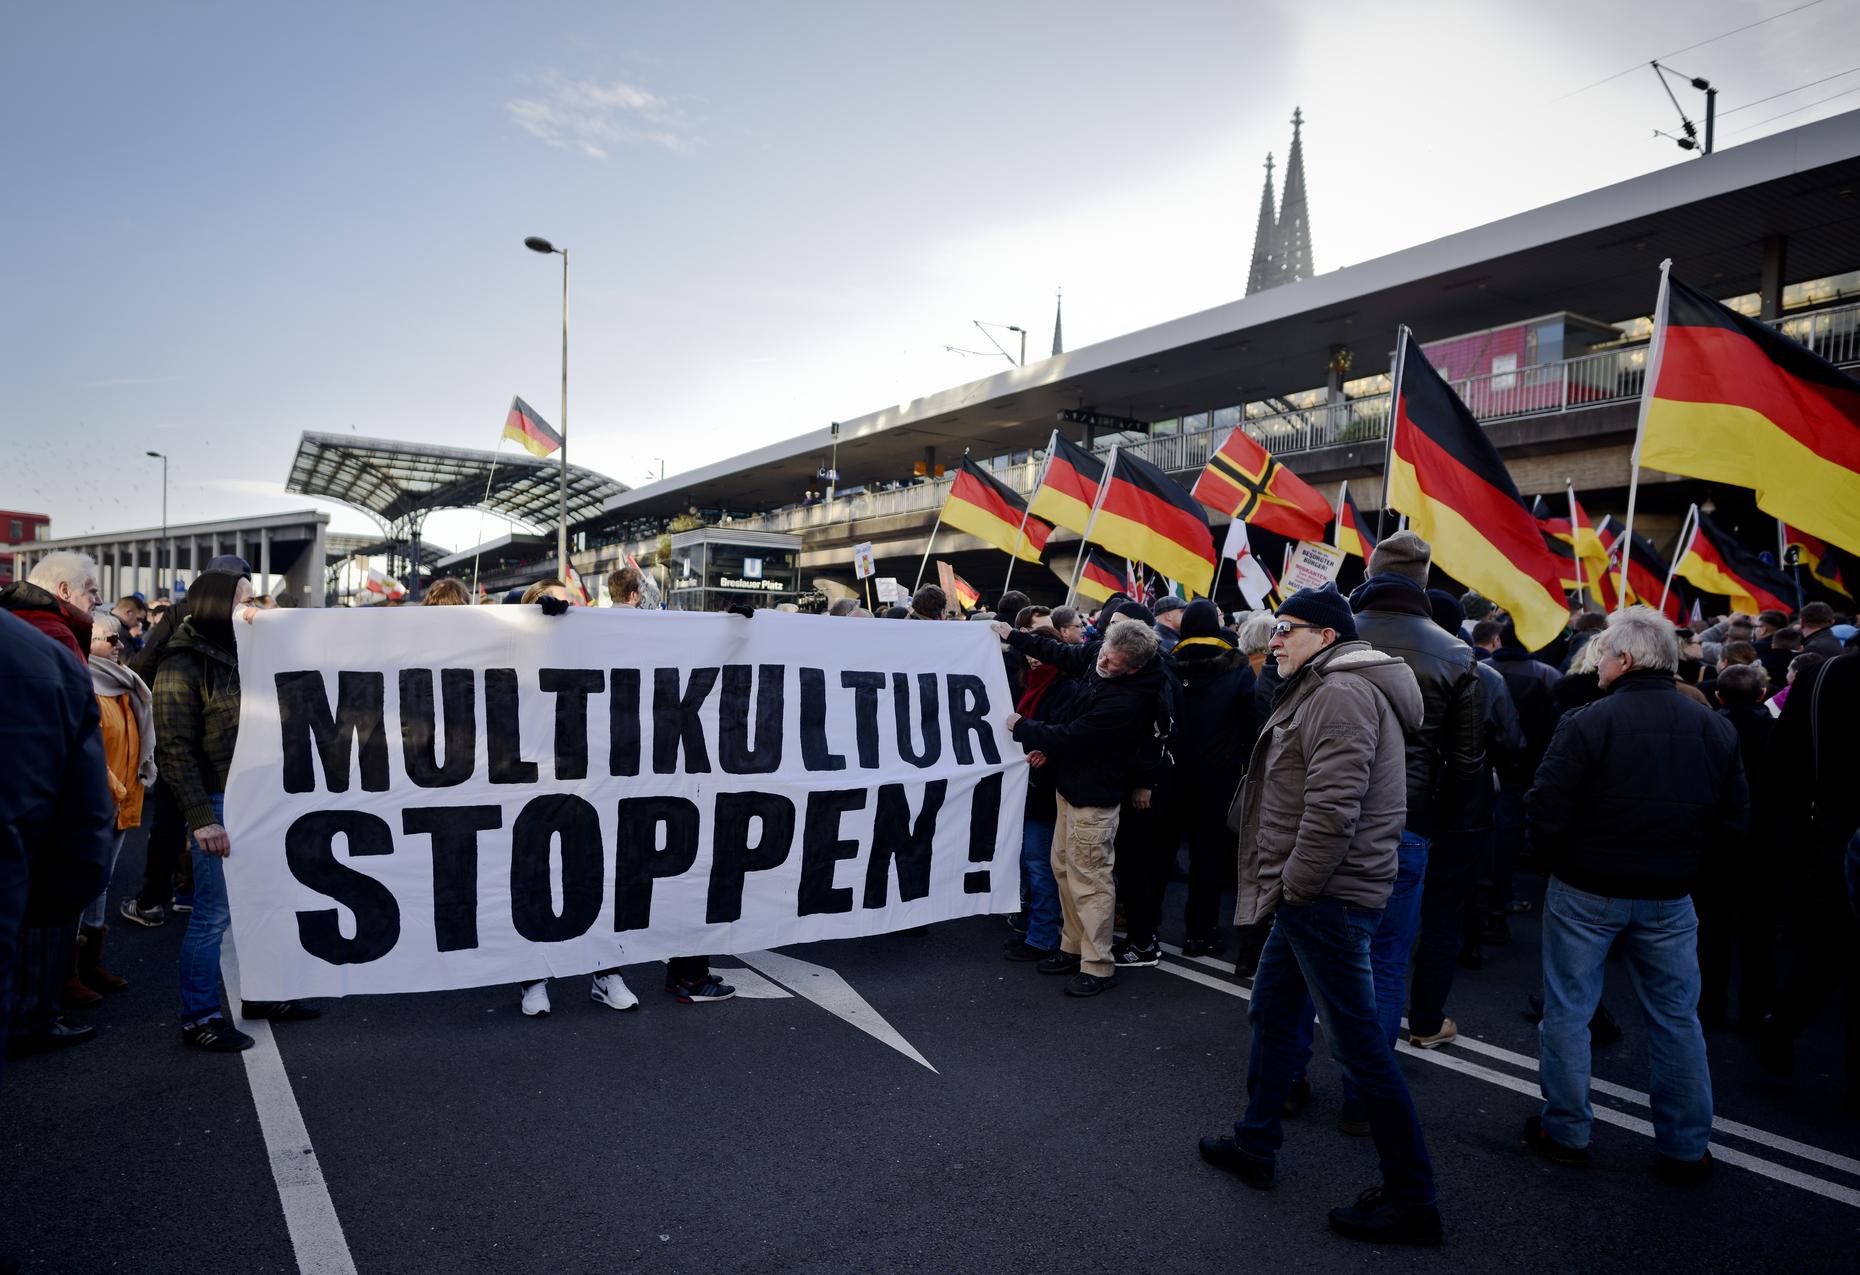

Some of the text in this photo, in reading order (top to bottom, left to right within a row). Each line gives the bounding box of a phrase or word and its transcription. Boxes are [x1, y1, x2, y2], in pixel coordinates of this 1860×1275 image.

[720, 577, 784, 591] Breslauer Platz
[745, 559, 762, 577] U
[275, 664, 1002, 794] MULTIKULTUR
[285, 772, 1004, 965] STOPPEN!
